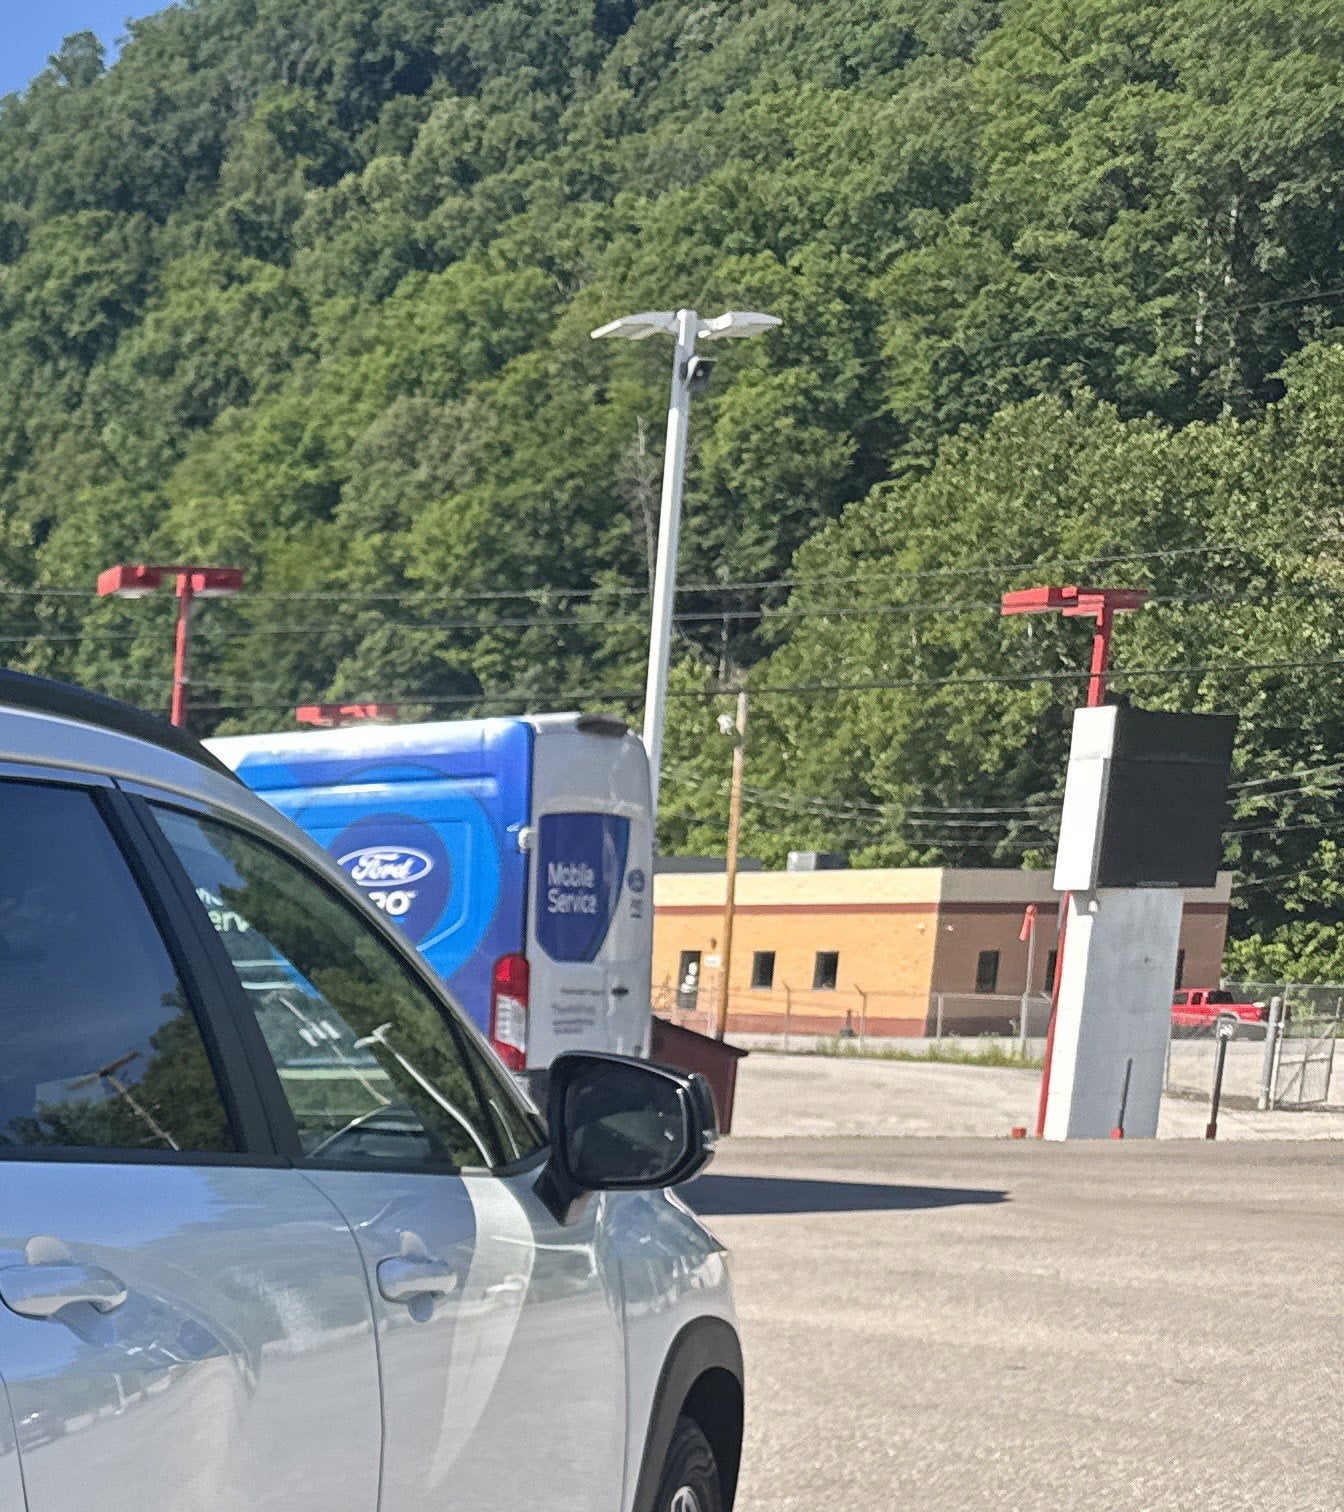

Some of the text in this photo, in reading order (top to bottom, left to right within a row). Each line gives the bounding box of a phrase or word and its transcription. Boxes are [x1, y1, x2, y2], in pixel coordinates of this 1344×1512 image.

[351, 853, 416, 880] Ford
[548, 862, 595, 888] Mobile
[548, 888, 598, 914] Service
